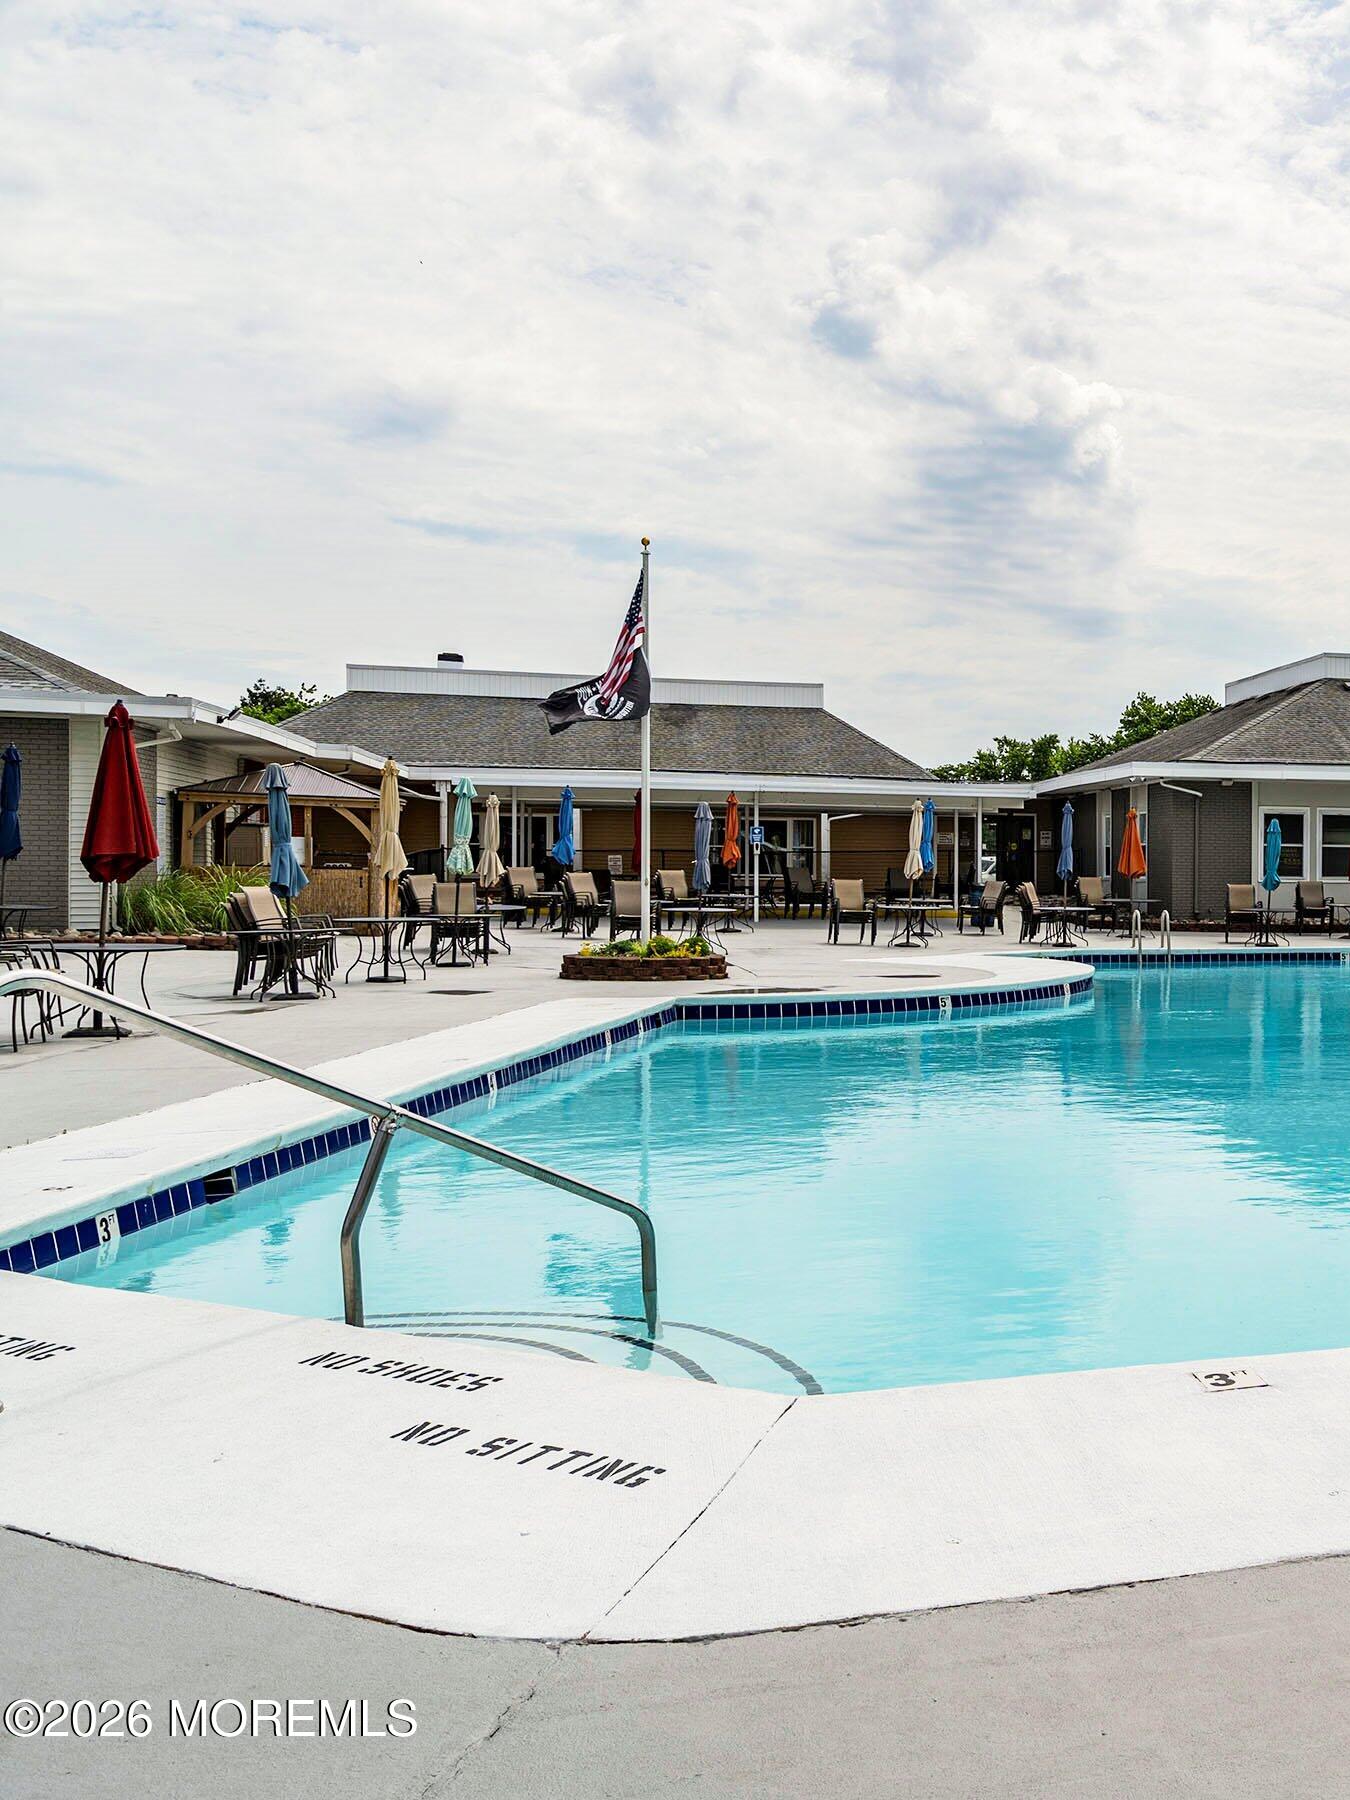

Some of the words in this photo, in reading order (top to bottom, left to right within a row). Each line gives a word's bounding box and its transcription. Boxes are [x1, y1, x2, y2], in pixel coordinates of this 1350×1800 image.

[100, 1217, 111, 1243] 3
[0, 1334, 76, 1361] TING
[298, 1351, 371, 1370] NO
[357, 1360, 504, 1392] SHOES
[1203, 1373, 1236, 1387] 3
[389, 1421, 471, 1446] NO
[465, 1437, 667, 1488] SITTING
